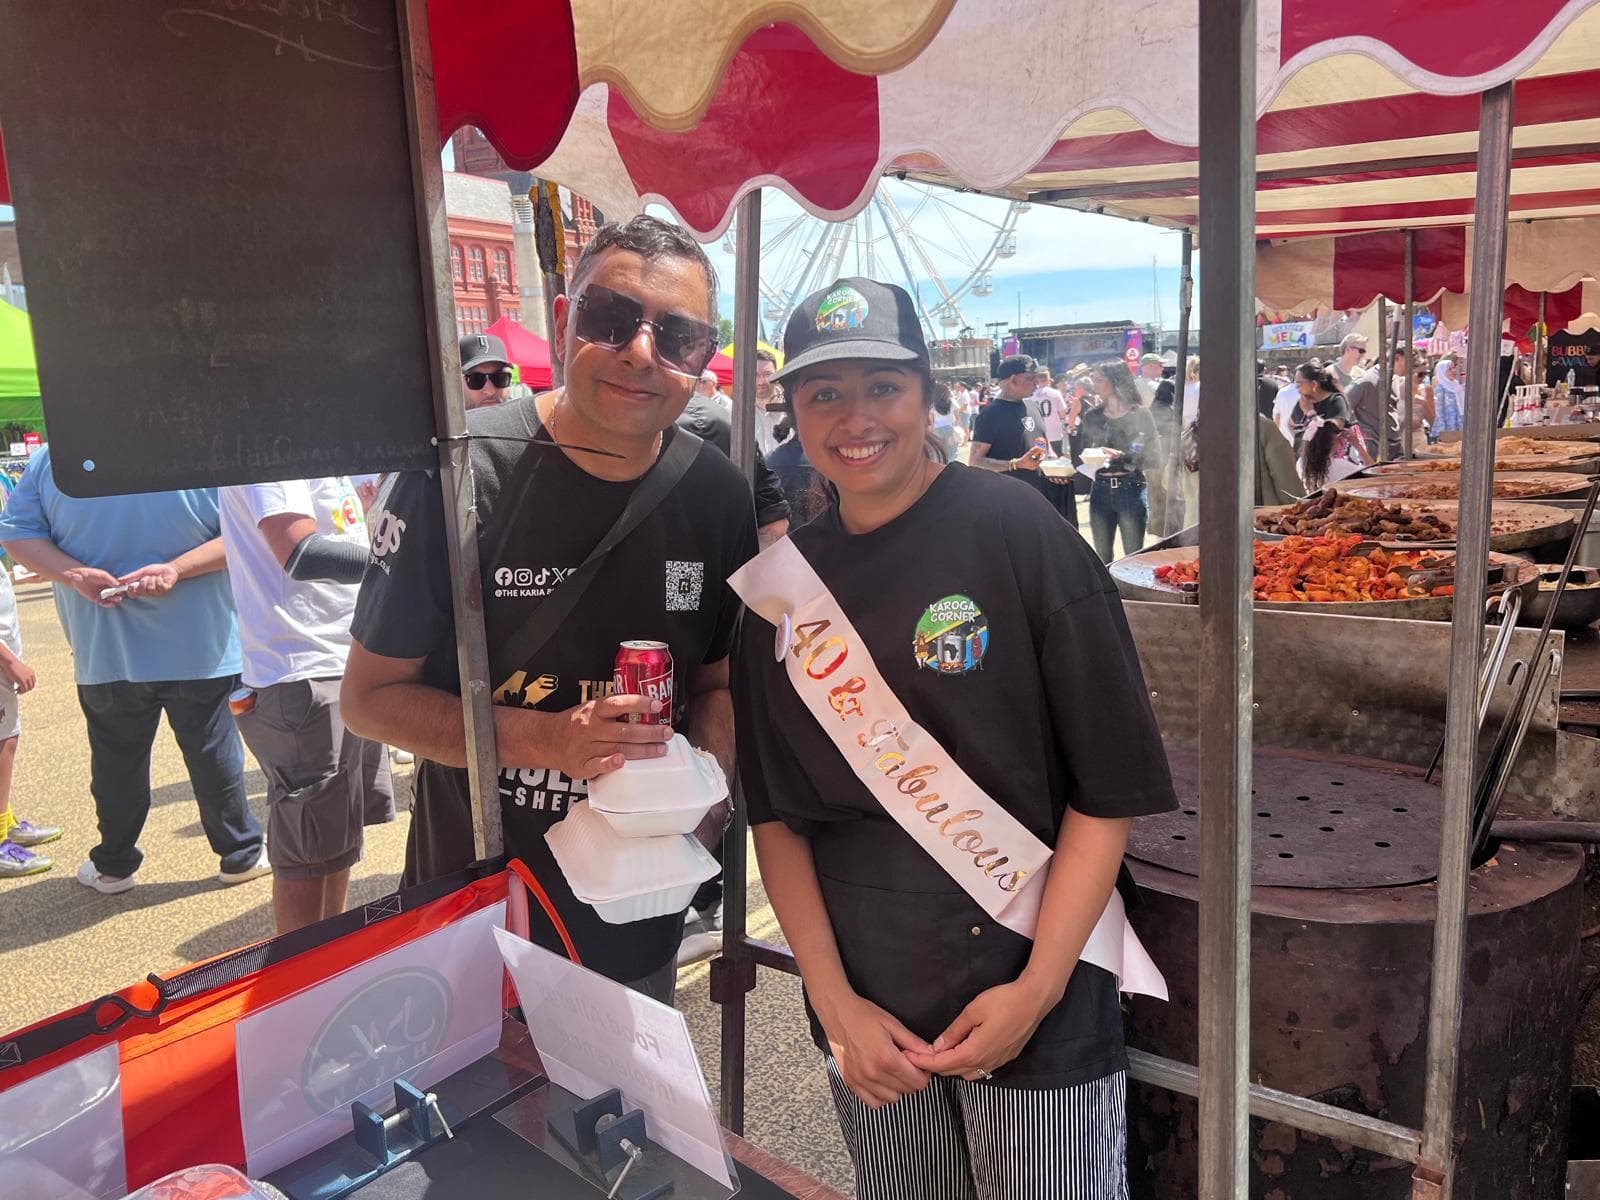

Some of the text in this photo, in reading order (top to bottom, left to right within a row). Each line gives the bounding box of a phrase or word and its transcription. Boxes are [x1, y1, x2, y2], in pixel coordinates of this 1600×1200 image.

[1269, 331, 1307, 347] MELA
[1552, 345, 1591, 356] BUBB
[1560, 357, 1590, 368] WAL
[495, 588, 518, 598] @THE
[519, 588, 546, 597] KARIA
[929, 600, 975, 614] KAROGA
[930, 611, 976, 624] CORNER
[791, 618, 849, 681] 40
[856, 718, 1028, 893] Fabulous
